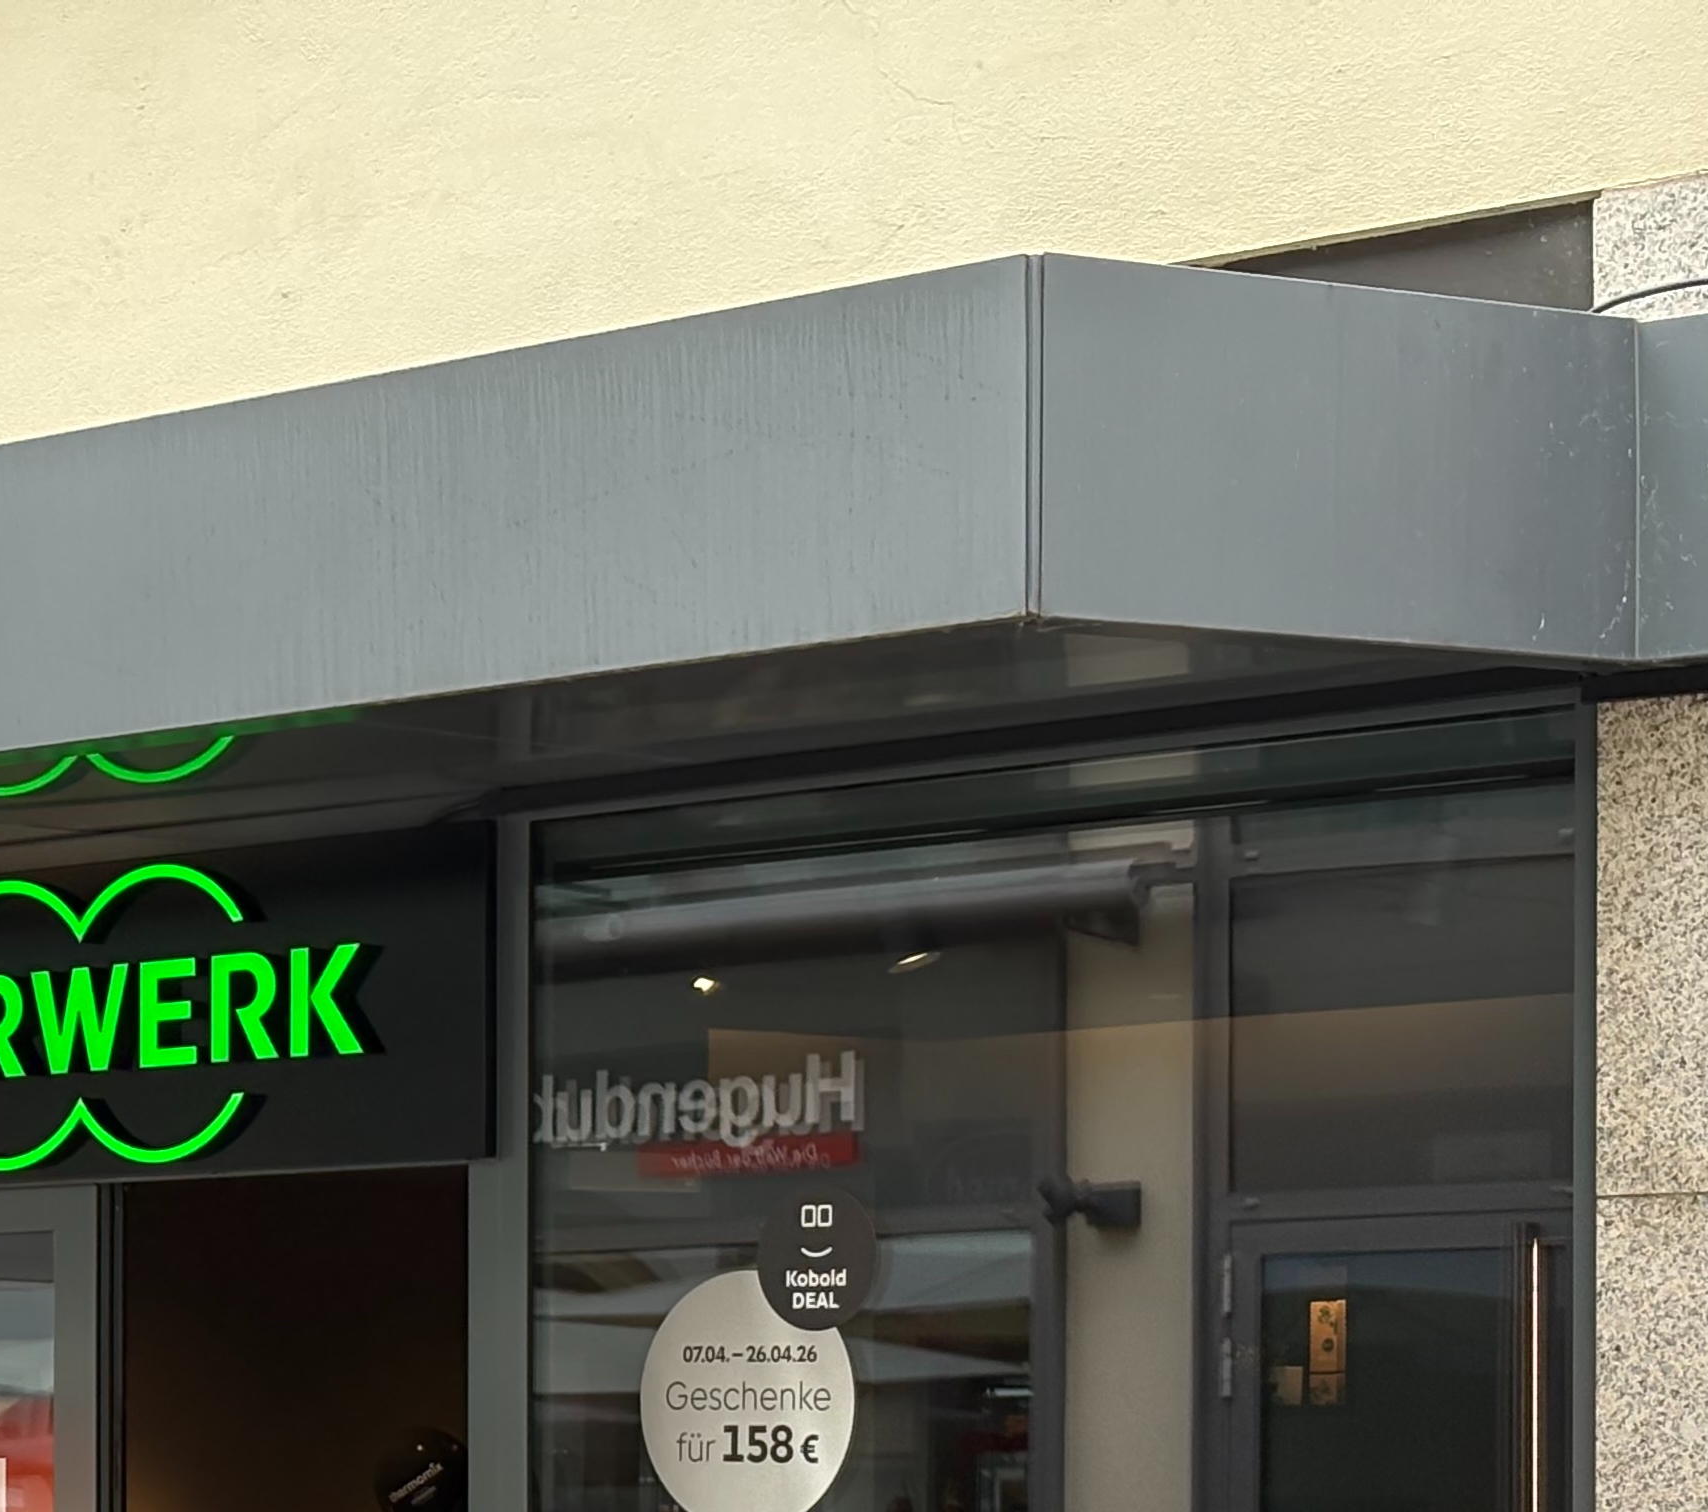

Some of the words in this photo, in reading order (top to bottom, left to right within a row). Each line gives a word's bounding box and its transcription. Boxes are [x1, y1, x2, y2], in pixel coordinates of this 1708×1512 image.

[786, 1268, 847, 1288] Kobold
[792, 1292, 840, 1309] DEAL
[666, 1381, 832, 1411] Geschenke
[676, 1432, 716, 1462] für
[722, 1424, 794, 1463] 158
[800, 1434, 819, 1463] €
